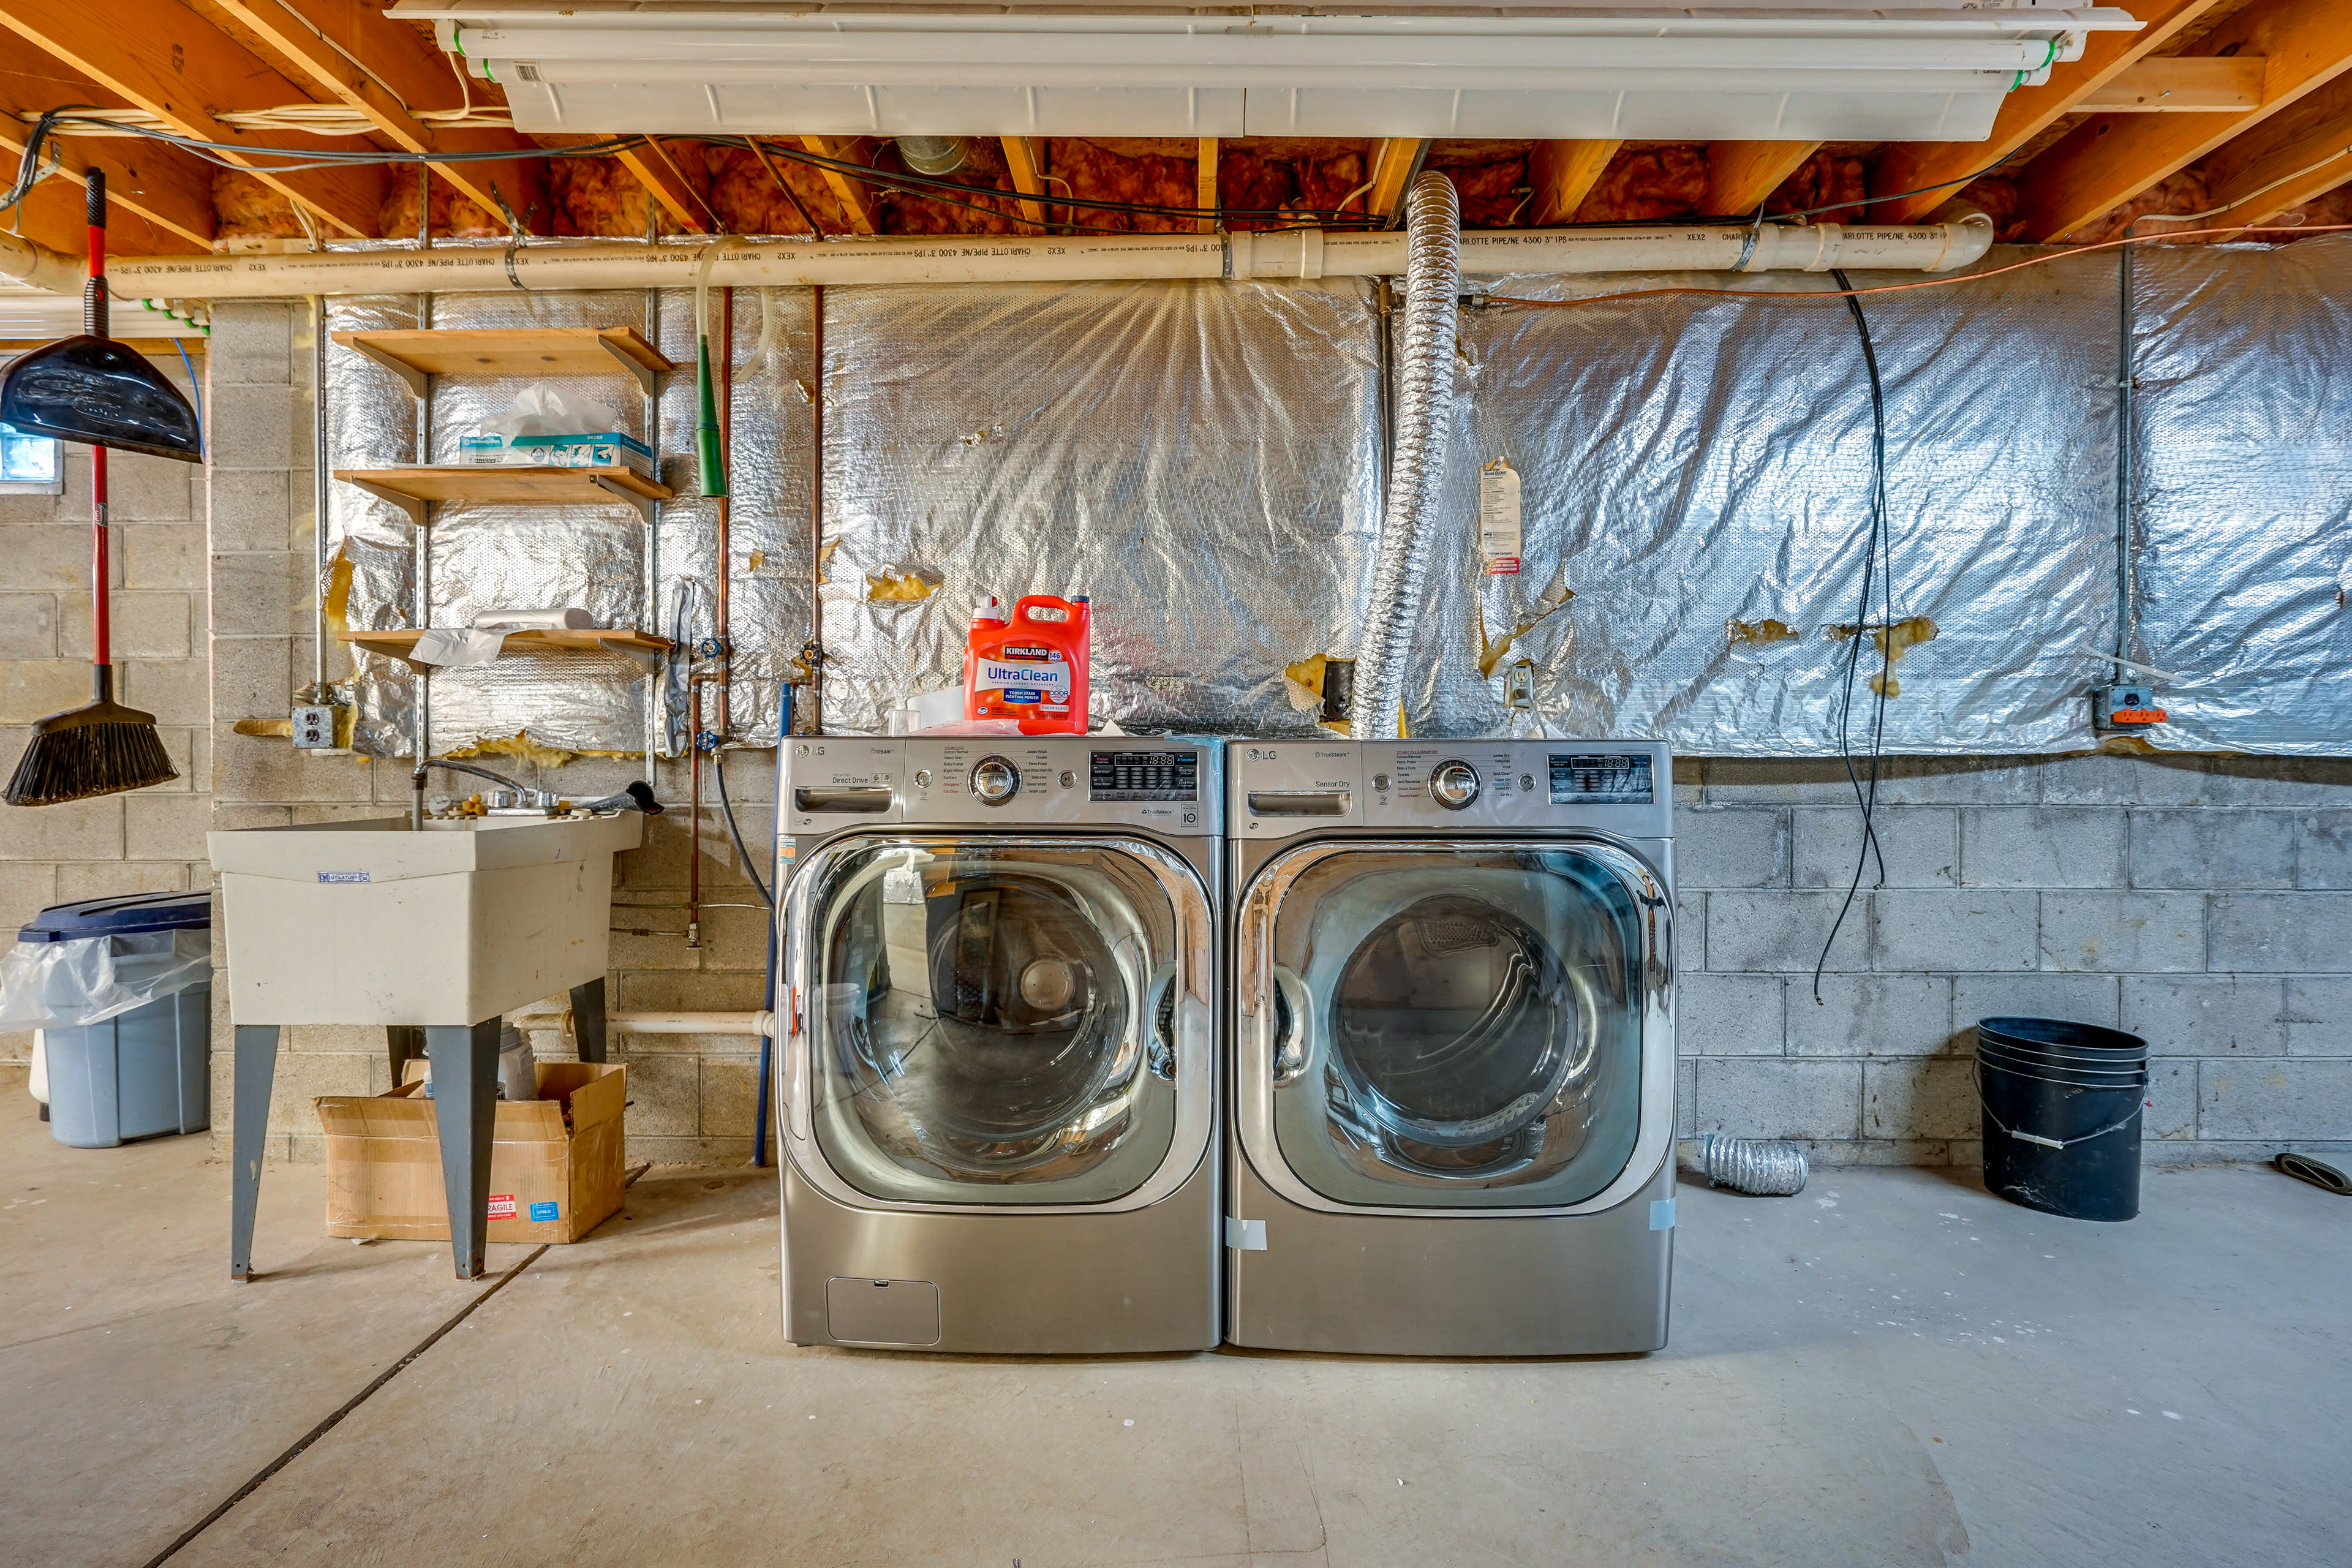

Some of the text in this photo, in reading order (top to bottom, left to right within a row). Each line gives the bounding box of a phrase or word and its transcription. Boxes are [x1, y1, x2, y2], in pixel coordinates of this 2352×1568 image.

[1523, 236, 1542, 244] 4300
[1186, 244, 1197, 252] IPS
[195, 264, 232, 272] CHARLOTTE
[988, 667, 1058, 681] UltraClean
[810, 747, 825, 756] LG
[1262, 751, 1276, 760] LG
[1183, 813, 1196, 823] 10
